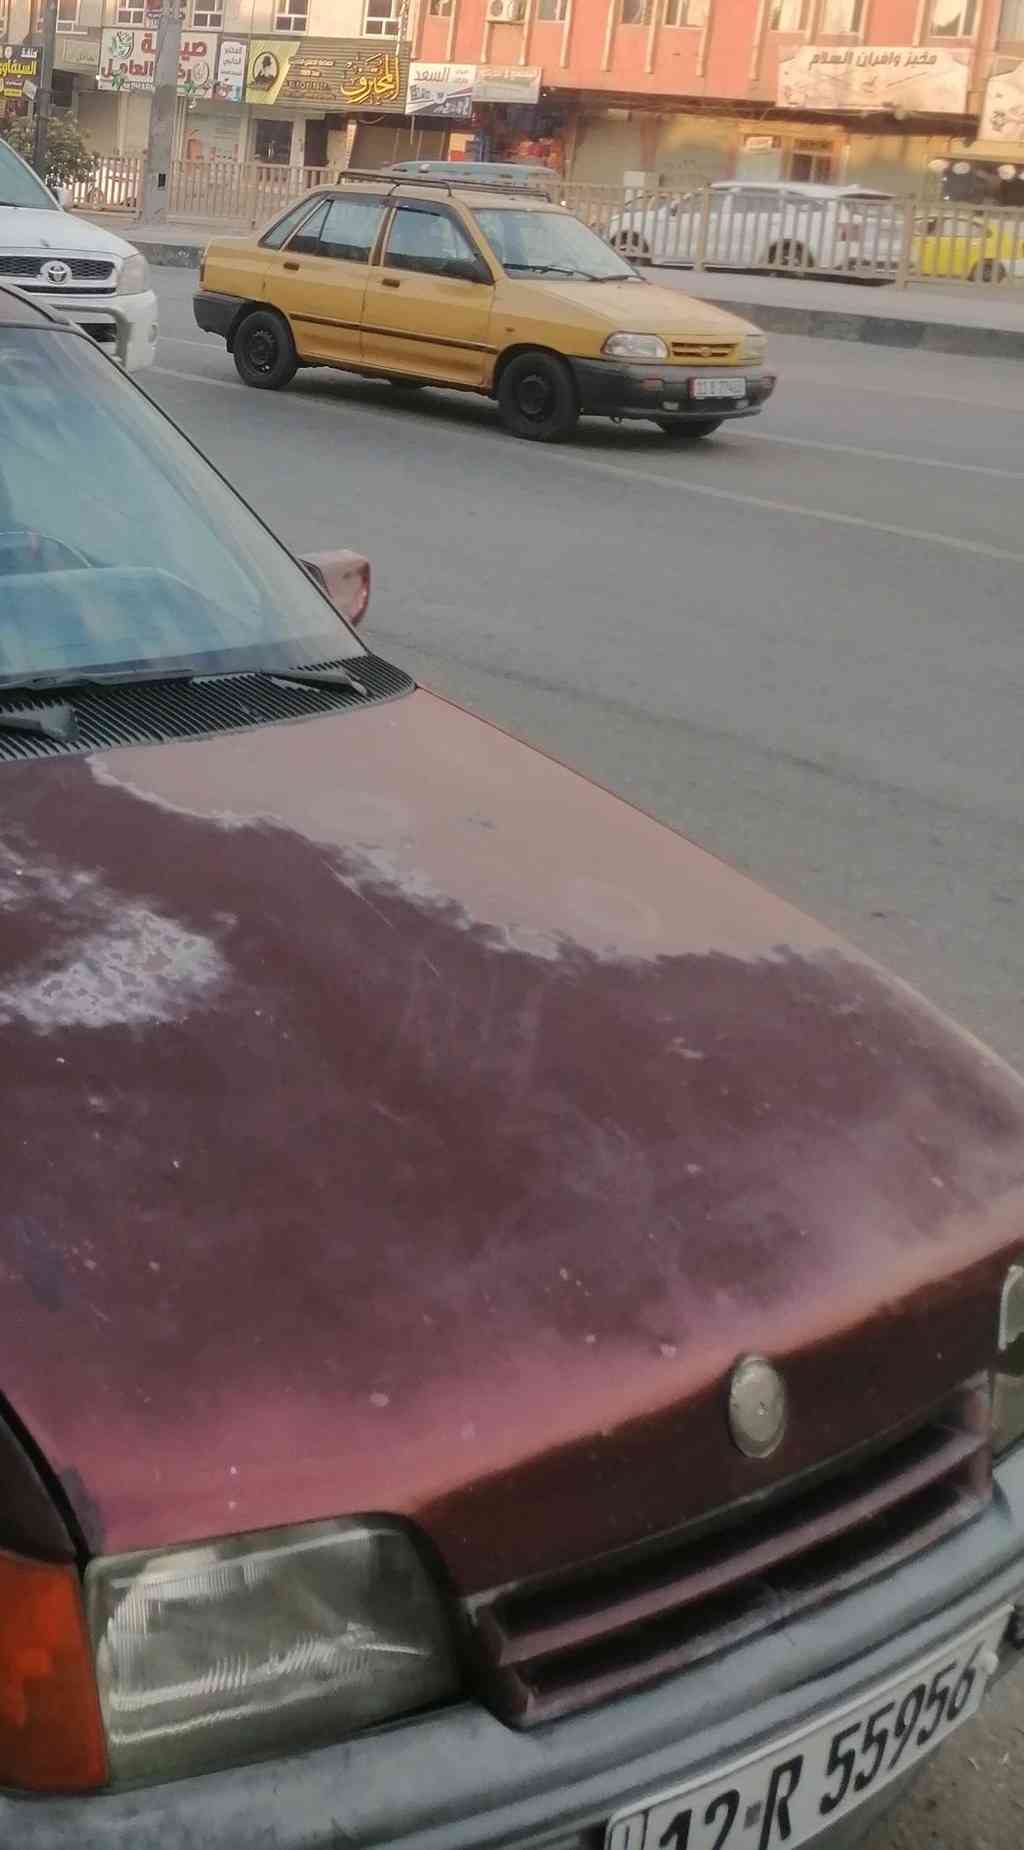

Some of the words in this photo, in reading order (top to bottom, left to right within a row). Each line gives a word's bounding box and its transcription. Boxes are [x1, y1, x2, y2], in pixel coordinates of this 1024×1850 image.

[808, 51, 853, 70] السلام
[904, 53, 938, 67] مخبز
[758, 1754, 804, 1850] R
[818, 1641, 984, 1815] 55956
